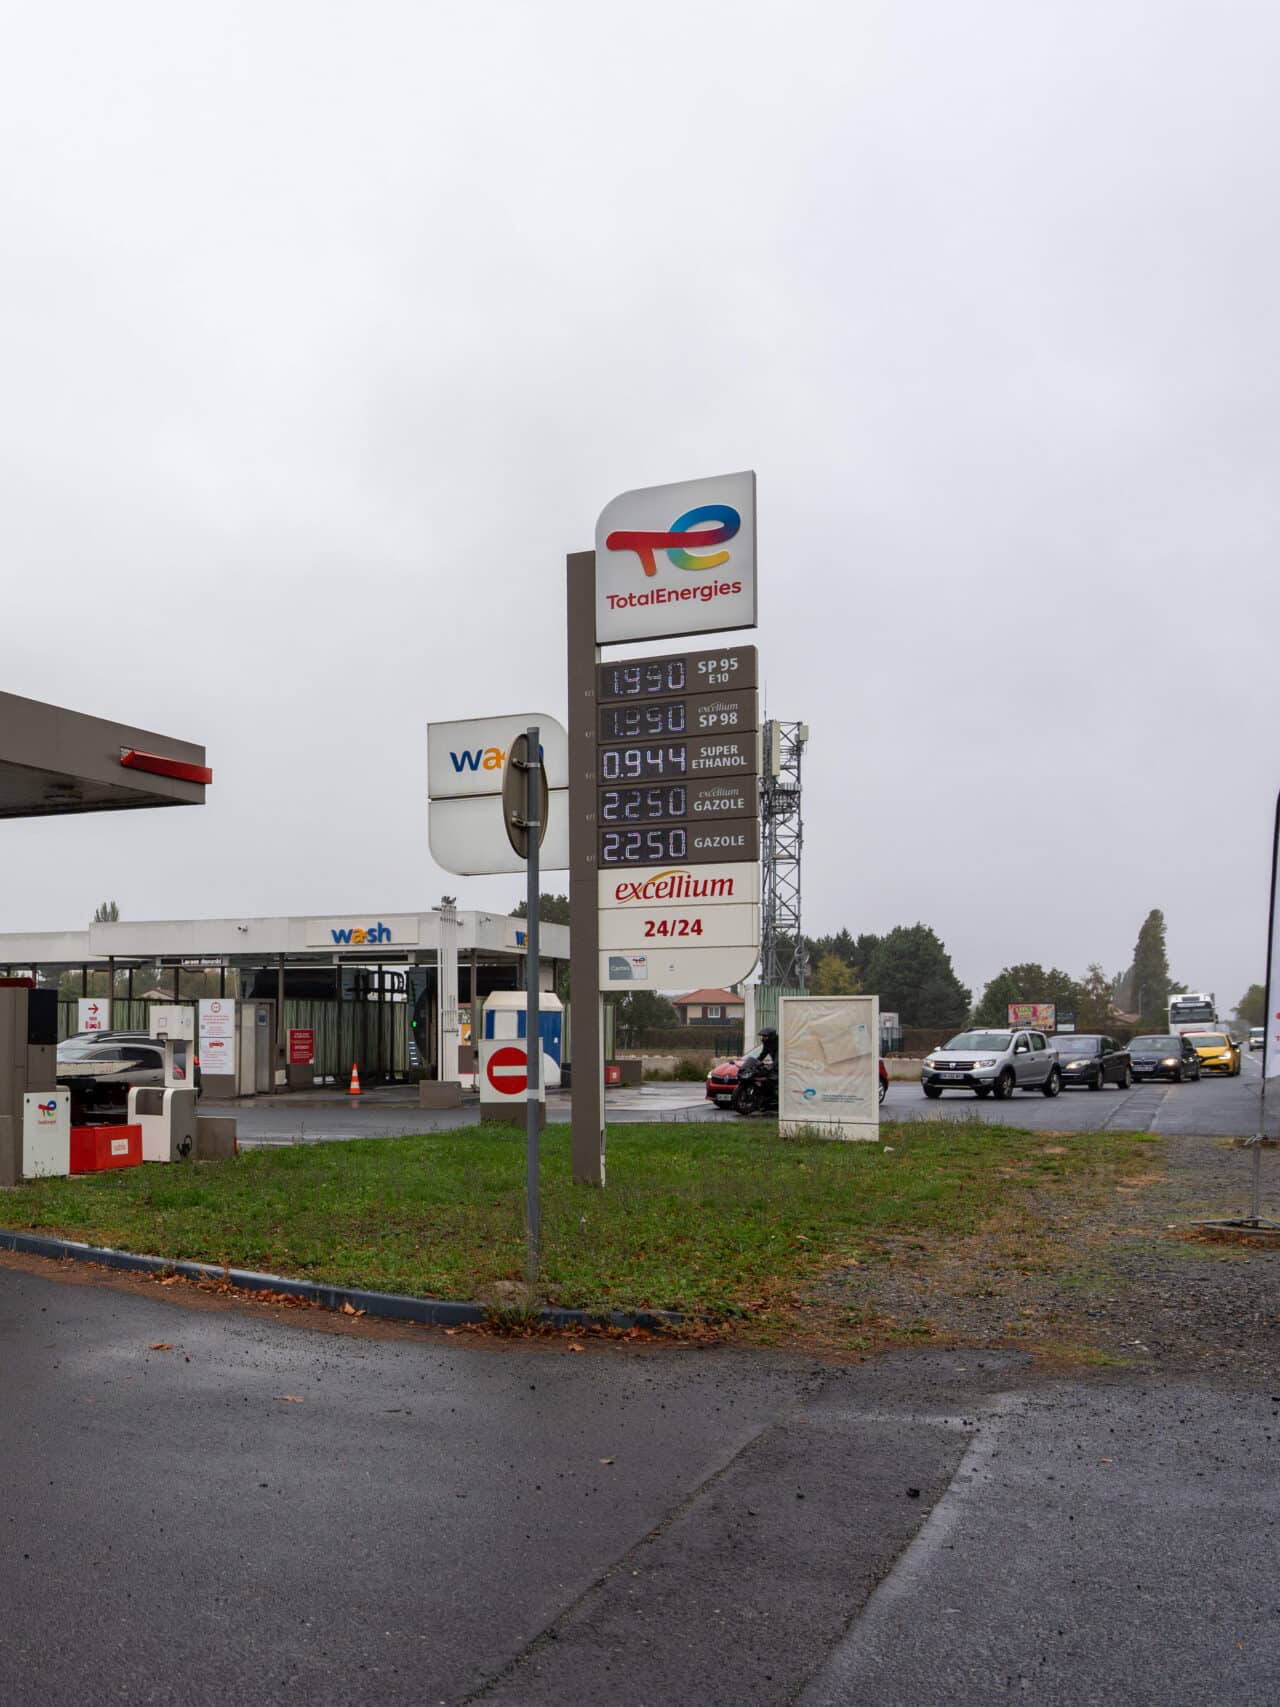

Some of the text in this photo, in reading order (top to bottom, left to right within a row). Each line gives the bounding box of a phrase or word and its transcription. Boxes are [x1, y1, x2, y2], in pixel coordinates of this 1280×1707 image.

[606, 580, 742, 610] TotalEnergies
[708, 673, 729, 684] E10
[450, 744, 544, 773] wa
[603, 748, 747, 779] 0.944 ETHANOL
[700, 744, 738, 757] SUPER
[693, 798, 745, 812] GAZOLE
[603, 829, 745, 861] 2.250 GAZOLE
[615, 869, 735, 904] excellium
[330, 920, 392, 944] wash
[644, 918, 704, 938] 24/24
